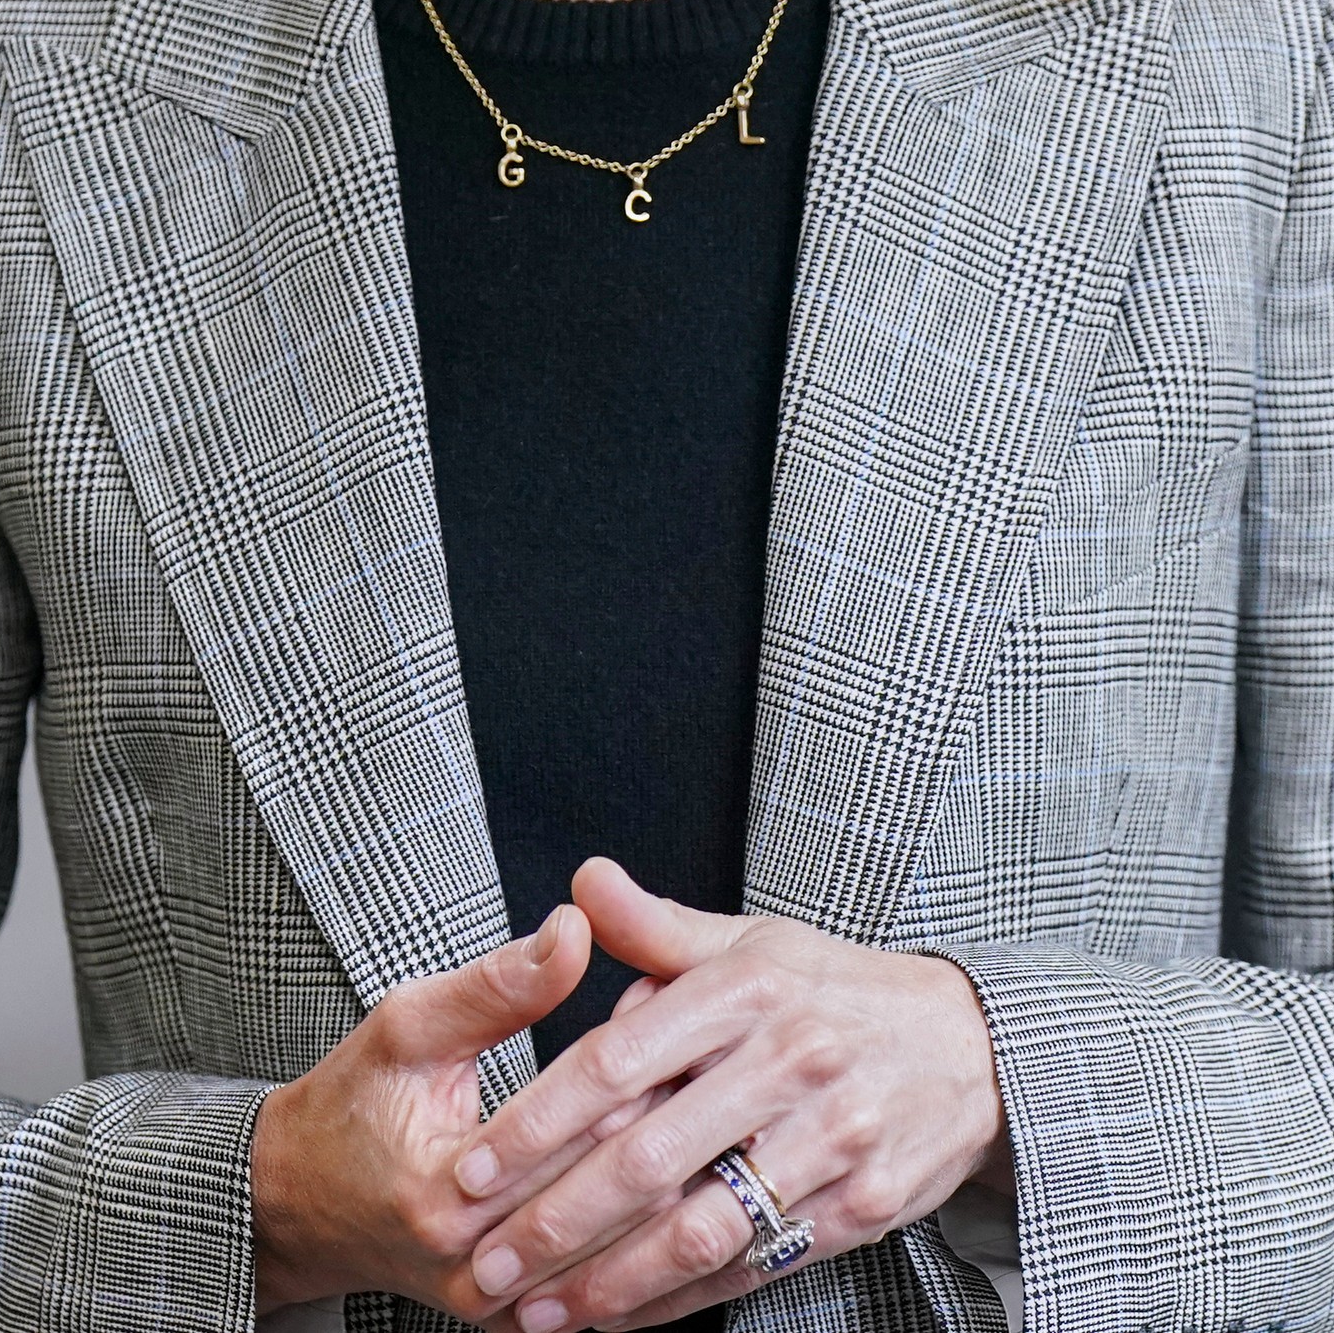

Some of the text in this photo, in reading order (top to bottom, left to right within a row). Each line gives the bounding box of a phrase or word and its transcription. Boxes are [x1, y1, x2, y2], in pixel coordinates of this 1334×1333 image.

[498, 102, 766, 223] G C L
